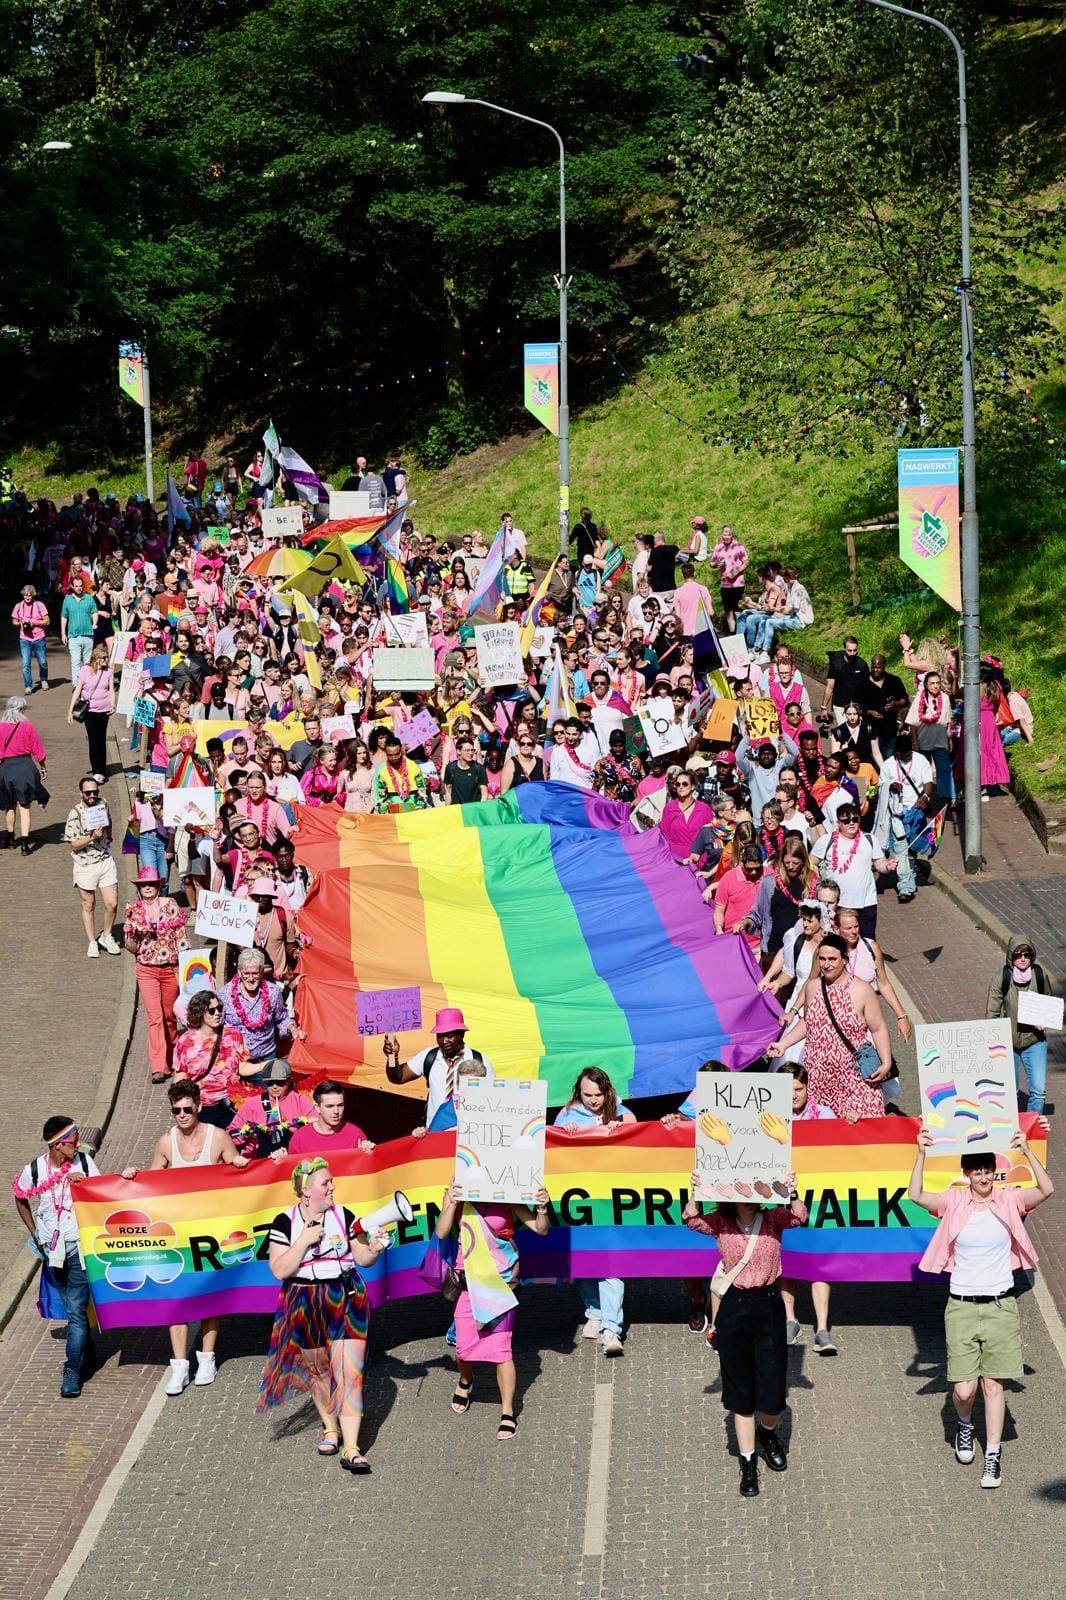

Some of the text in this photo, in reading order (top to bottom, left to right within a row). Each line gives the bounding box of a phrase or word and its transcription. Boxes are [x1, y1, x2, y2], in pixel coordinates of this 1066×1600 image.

[204, 894, 248, 913] LOVE IS
[210, 914, 241, 928] LOVE
[922, 1026, 1001, 1049] GUESS
[948, 1049, 977, 1060] THE
[939, 1059, 994, 1074] FLAG
[714, 1082, 772, 1110] KLAP
[458, 1121, 513, 1148] PRIDE
[485, 1165, 542, 1187] WALK
[119, 1226, 148, 1235] ROZE
[105, 1239, 167, 1249] WOENSDAG
